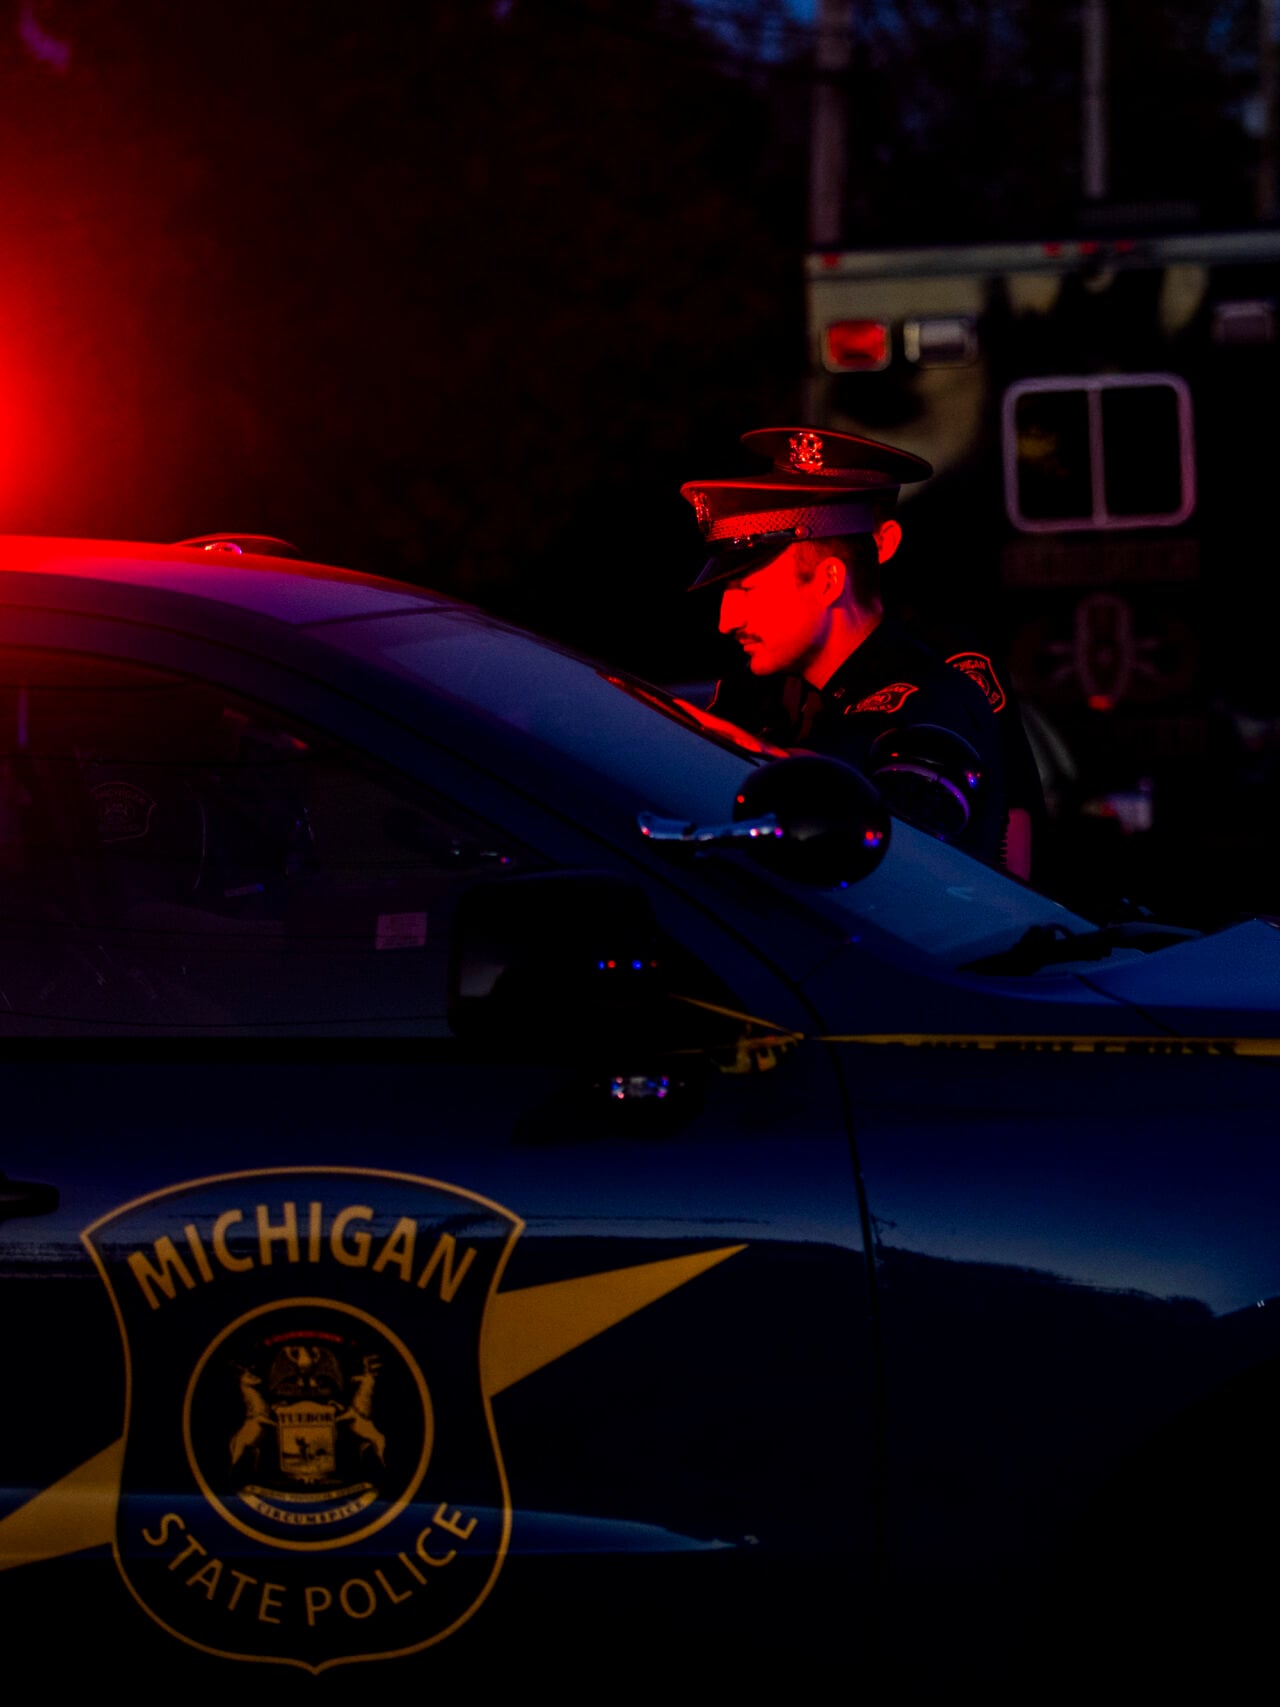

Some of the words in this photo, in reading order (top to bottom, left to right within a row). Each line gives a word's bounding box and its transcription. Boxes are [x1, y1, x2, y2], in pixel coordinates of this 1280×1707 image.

[126, 1201, 479, 1311] MICHIGAN
[141, 1512, 288, 1625] STATE
[305, 1501, 479, 1626] POLICE
